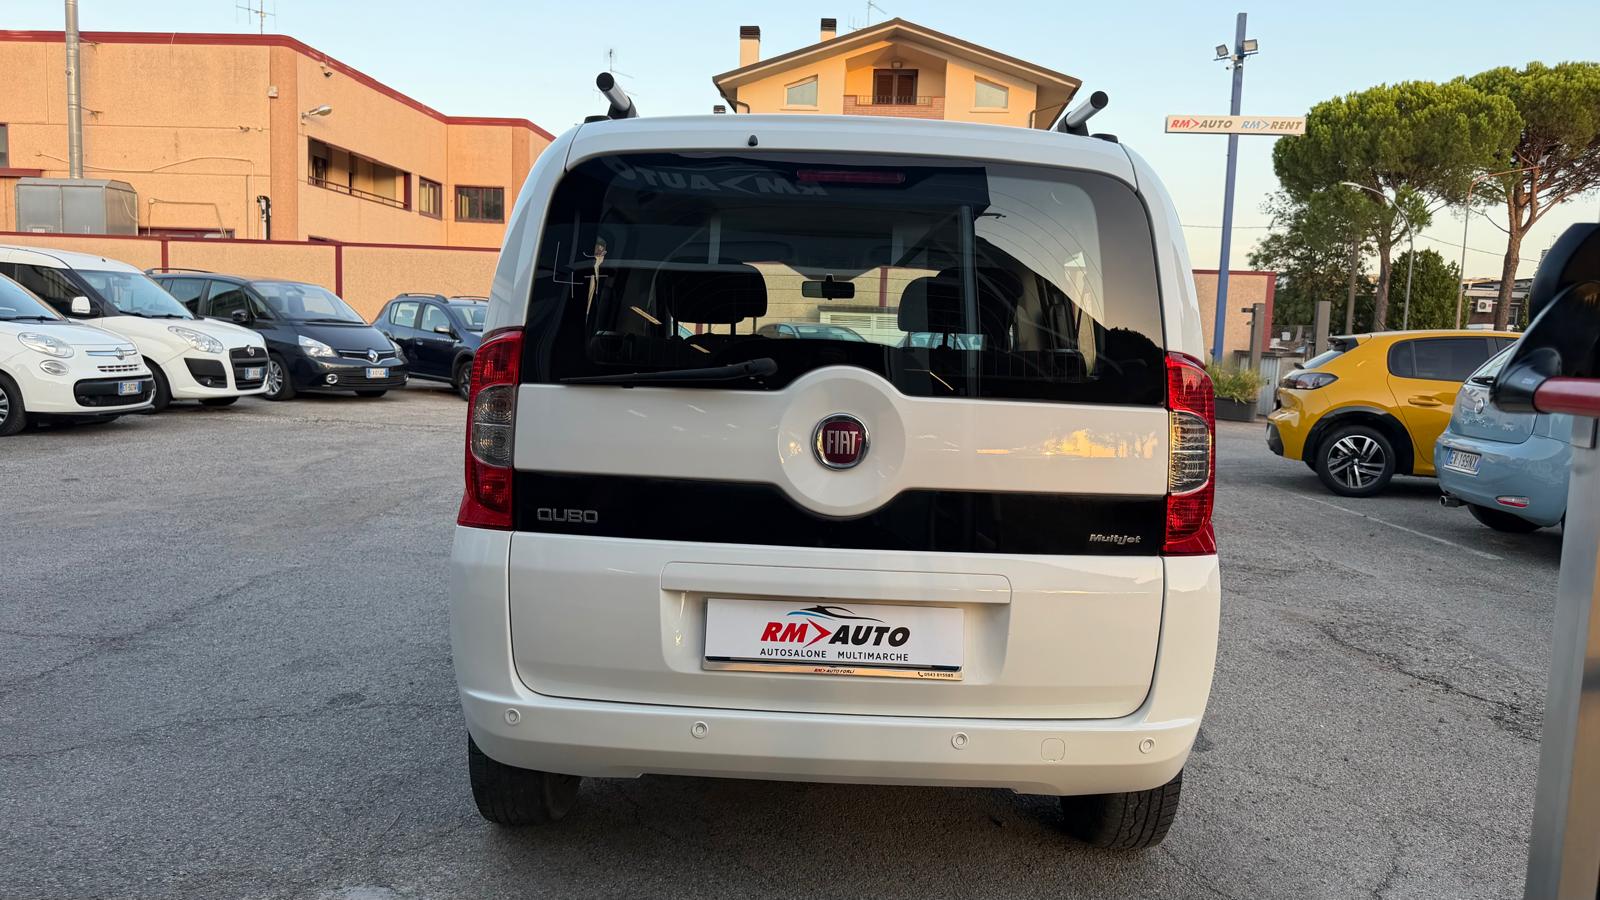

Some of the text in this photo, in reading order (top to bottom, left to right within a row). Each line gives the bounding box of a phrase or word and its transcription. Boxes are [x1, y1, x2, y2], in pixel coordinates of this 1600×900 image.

[1170, 119, 1303, 130] RM AUTO RM RENT
[826, 430, 859, 455] FIAT
[537, 507, 599, 524] QUBO
[760, 621, 911, 647] RM AUTO
[759, 647, 909, 662] AUTOSALONE MULTIMARCHE
